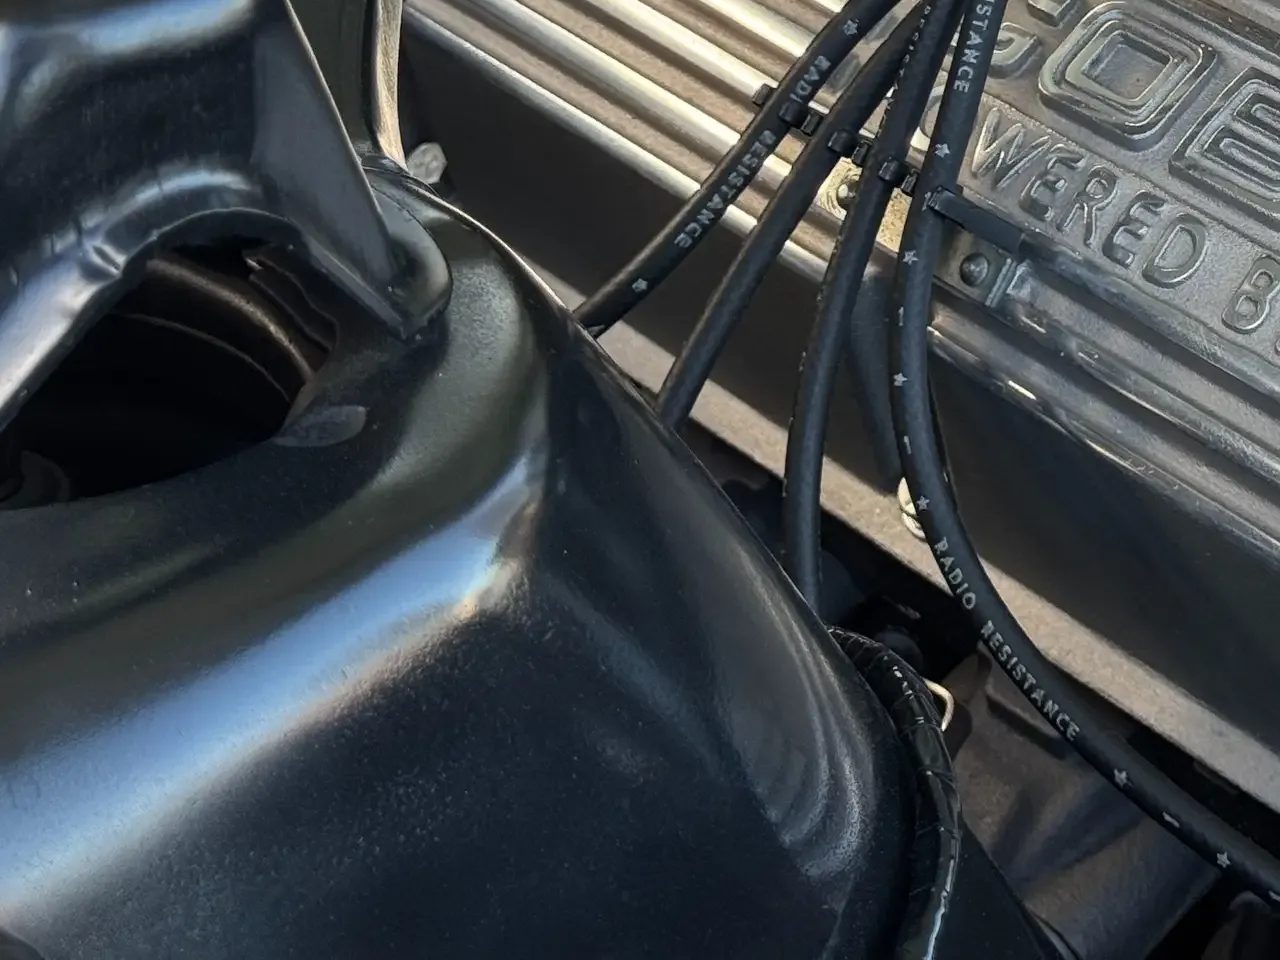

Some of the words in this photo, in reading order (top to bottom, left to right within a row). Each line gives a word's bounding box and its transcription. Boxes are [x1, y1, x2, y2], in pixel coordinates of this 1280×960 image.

[789, 55, 832, 104] RADI
[673, 129, 777, 248] RESISTANCE
[970, 105, 1208, 288] WERED
[933, 536, 976, 610] RADIO
[980, 619, 1080, 742] RESISTANCE
